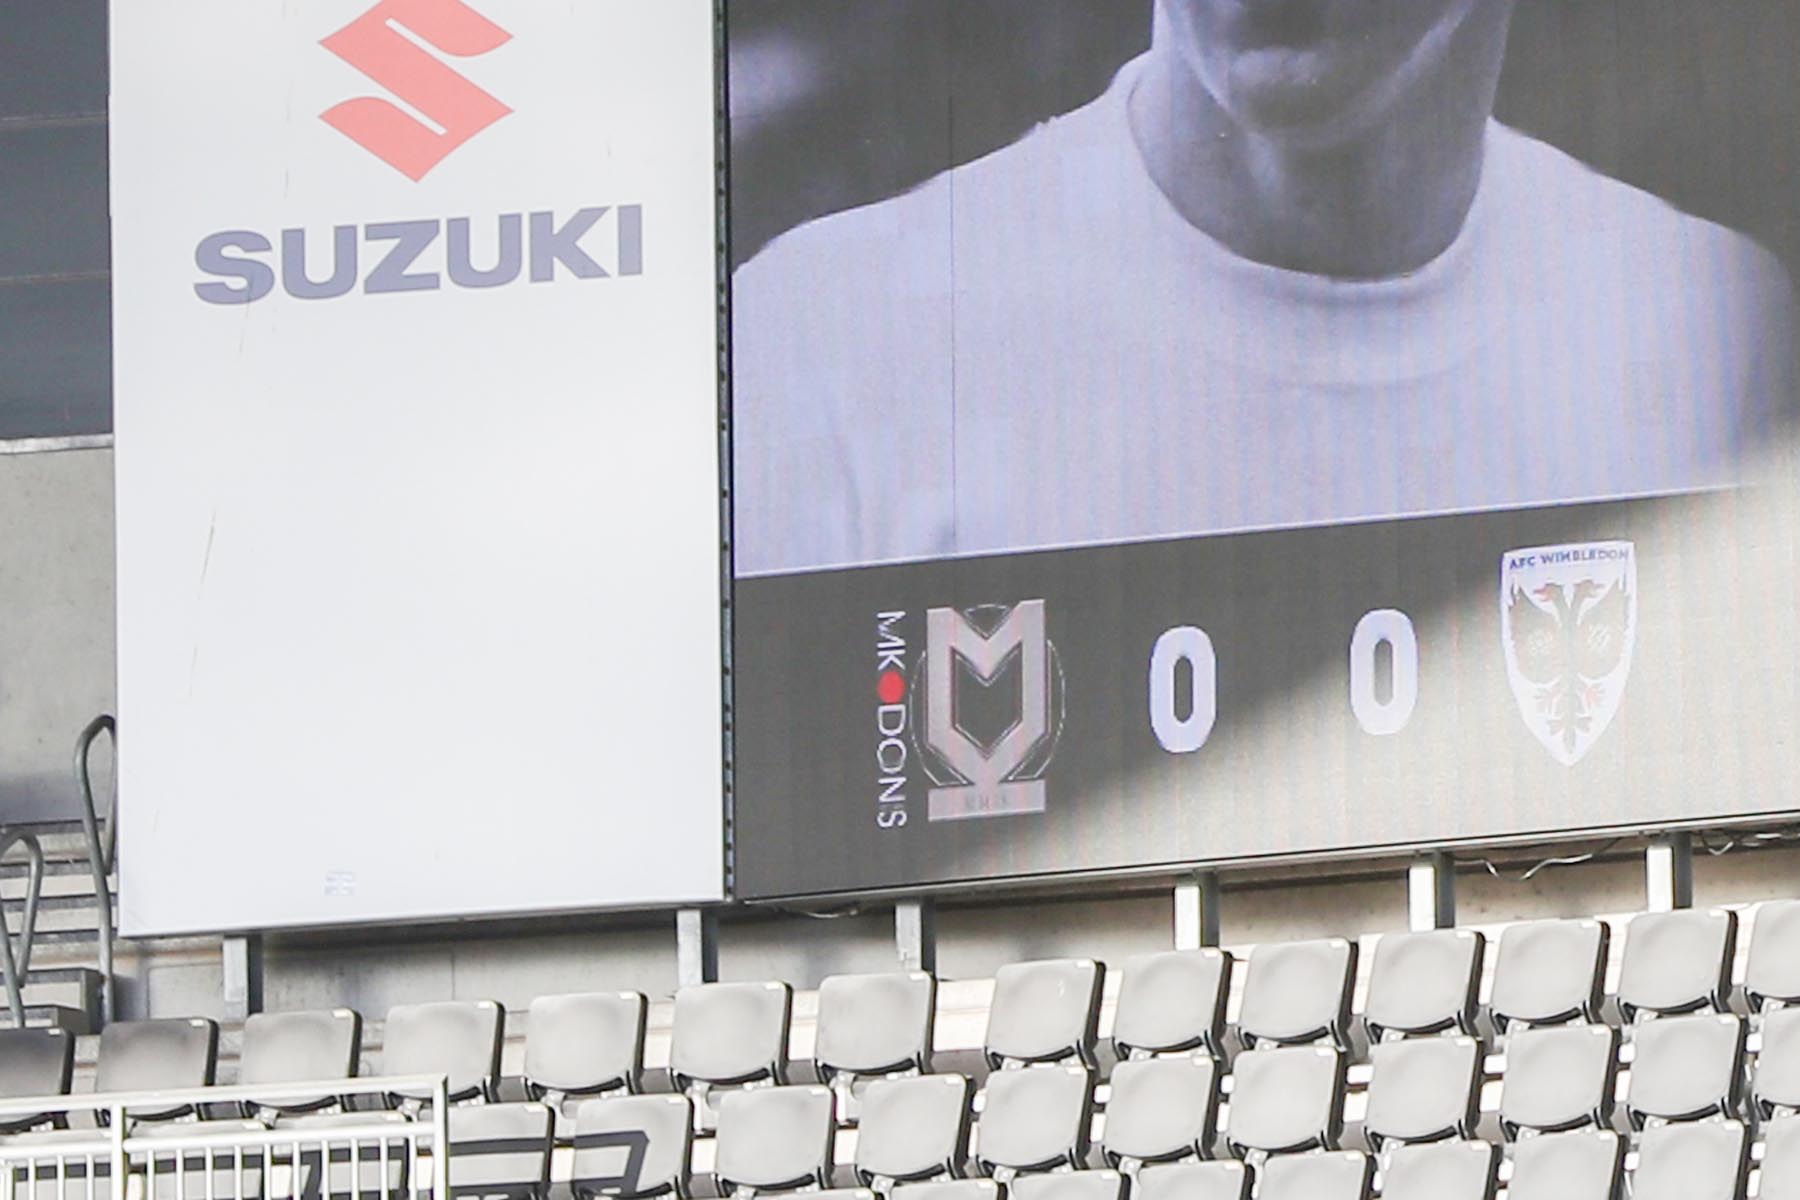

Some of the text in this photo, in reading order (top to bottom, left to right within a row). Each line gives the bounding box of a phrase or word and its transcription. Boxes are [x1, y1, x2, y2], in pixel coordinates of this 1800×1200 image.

[193, 203, 643, 306] SUZUKI
[1509, 547, 1630, 570] AFC WIMBLEDON
[1149, 608, 1419, 754] 0 0
